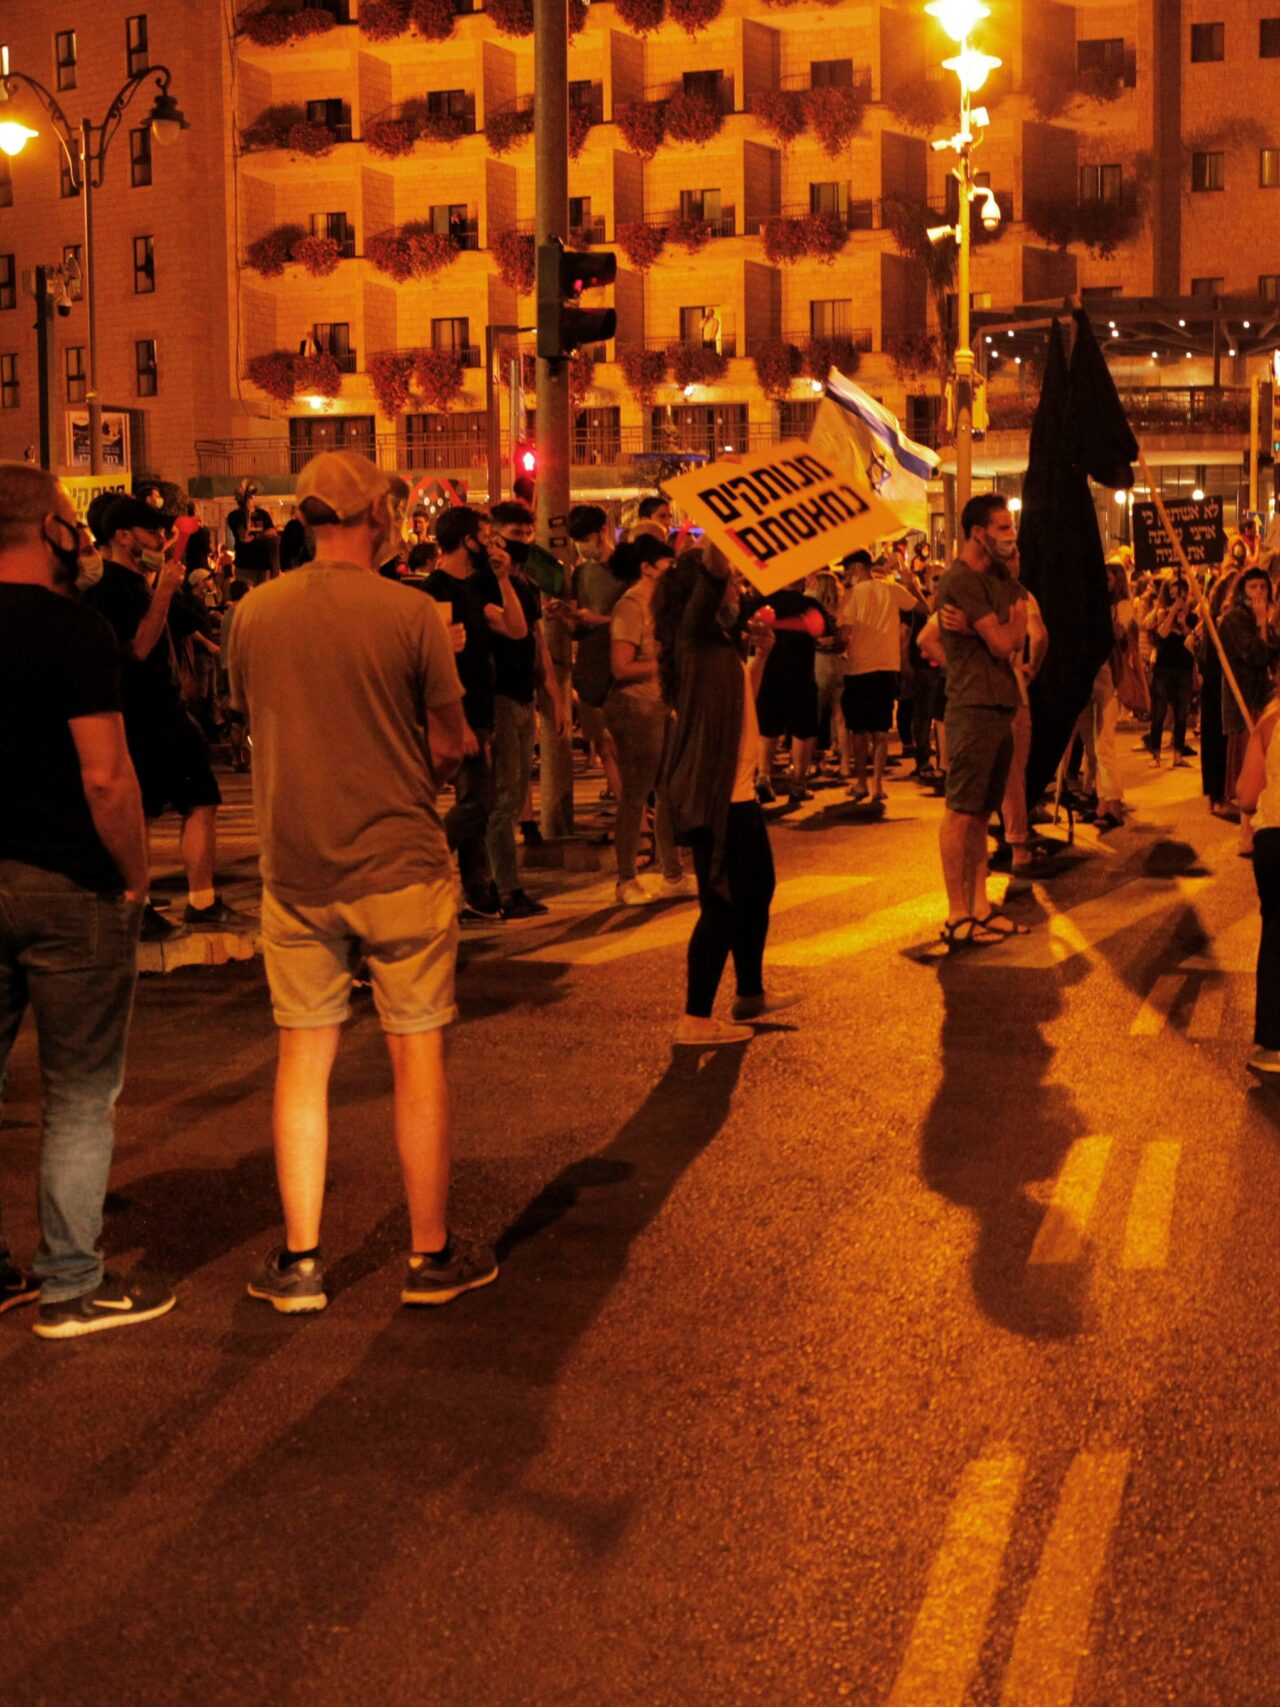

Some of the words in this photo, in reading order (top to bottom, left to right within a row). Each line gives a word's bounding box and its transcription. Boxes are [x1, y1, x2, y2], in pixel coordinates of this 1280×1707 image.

[697, 454, 835, 524] מנותקים
[1203, 498, 1219, 520] לא
[1187, 545, 1205, 560] את
